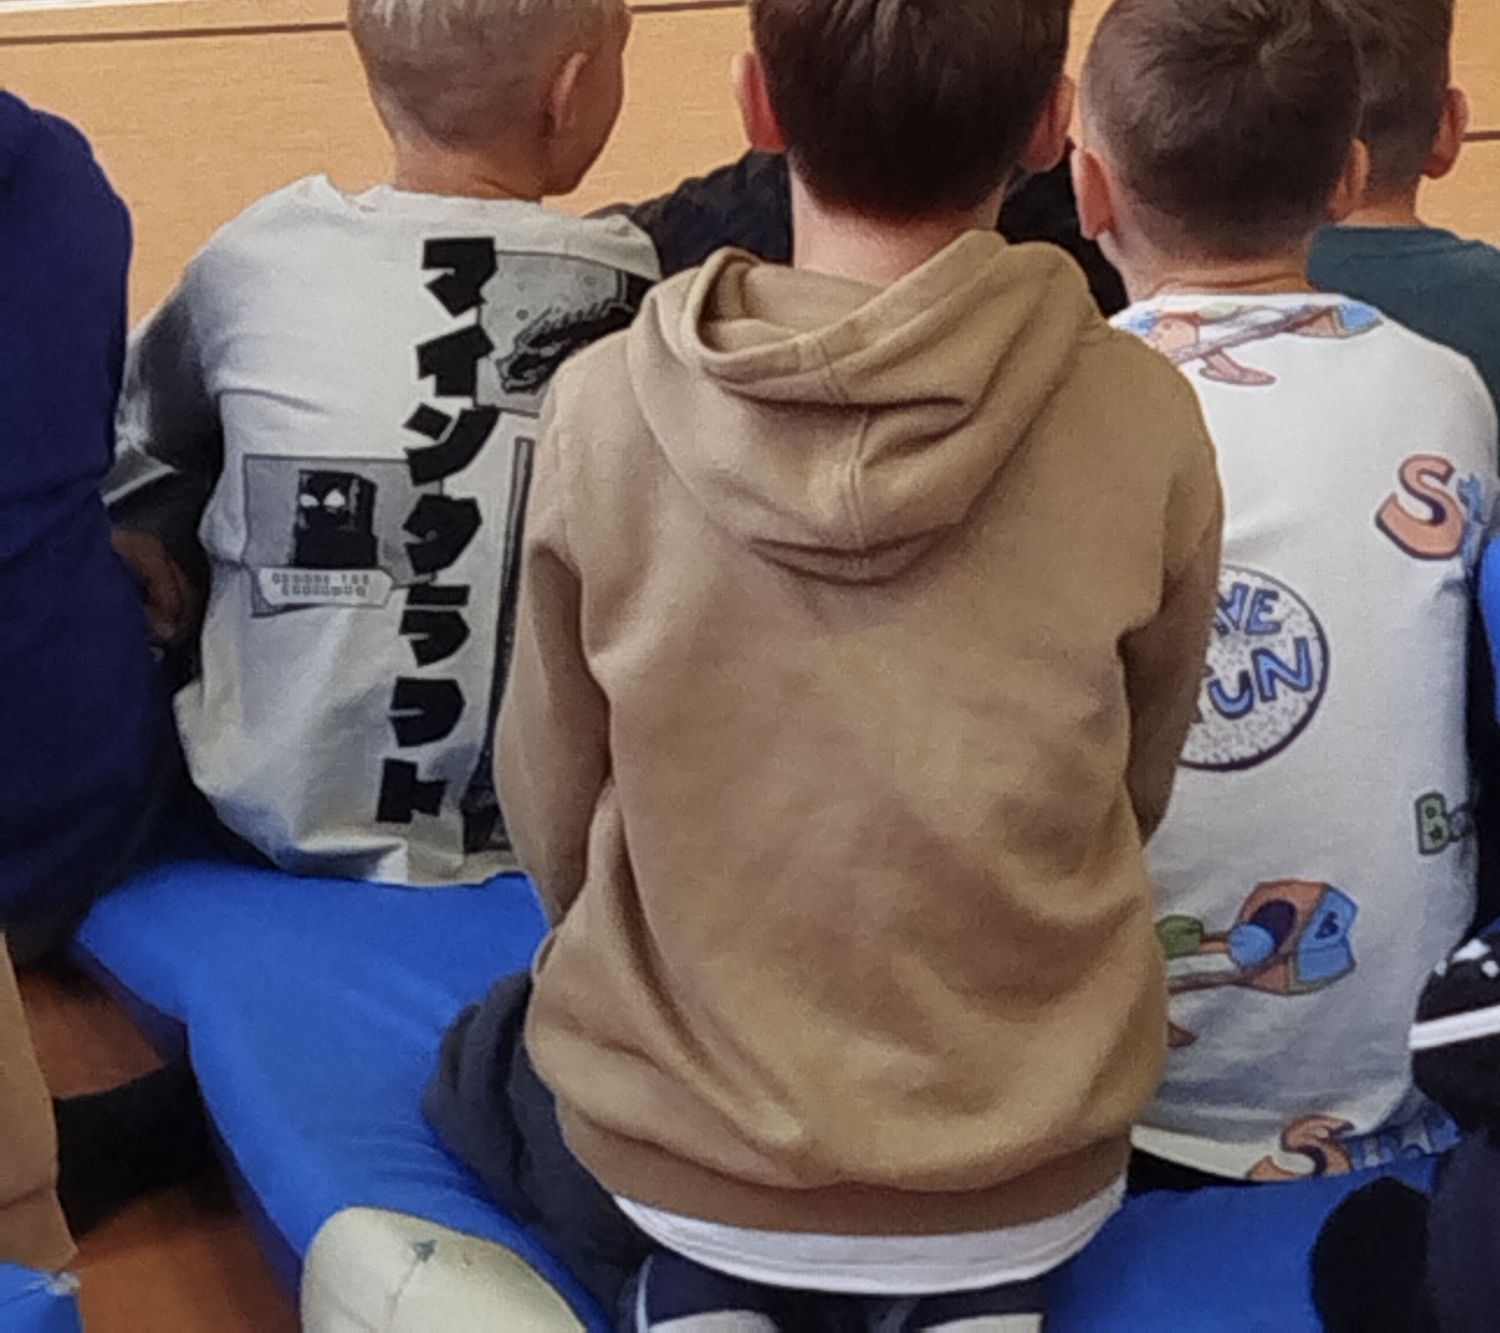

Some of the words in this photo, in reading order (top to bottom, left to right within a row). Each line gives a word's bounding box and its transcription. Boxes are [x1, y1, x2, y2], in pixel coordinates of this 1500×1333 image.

[376, 236, 498, 824] マインクラフト
[1206, 635, 1314, 720] UN
